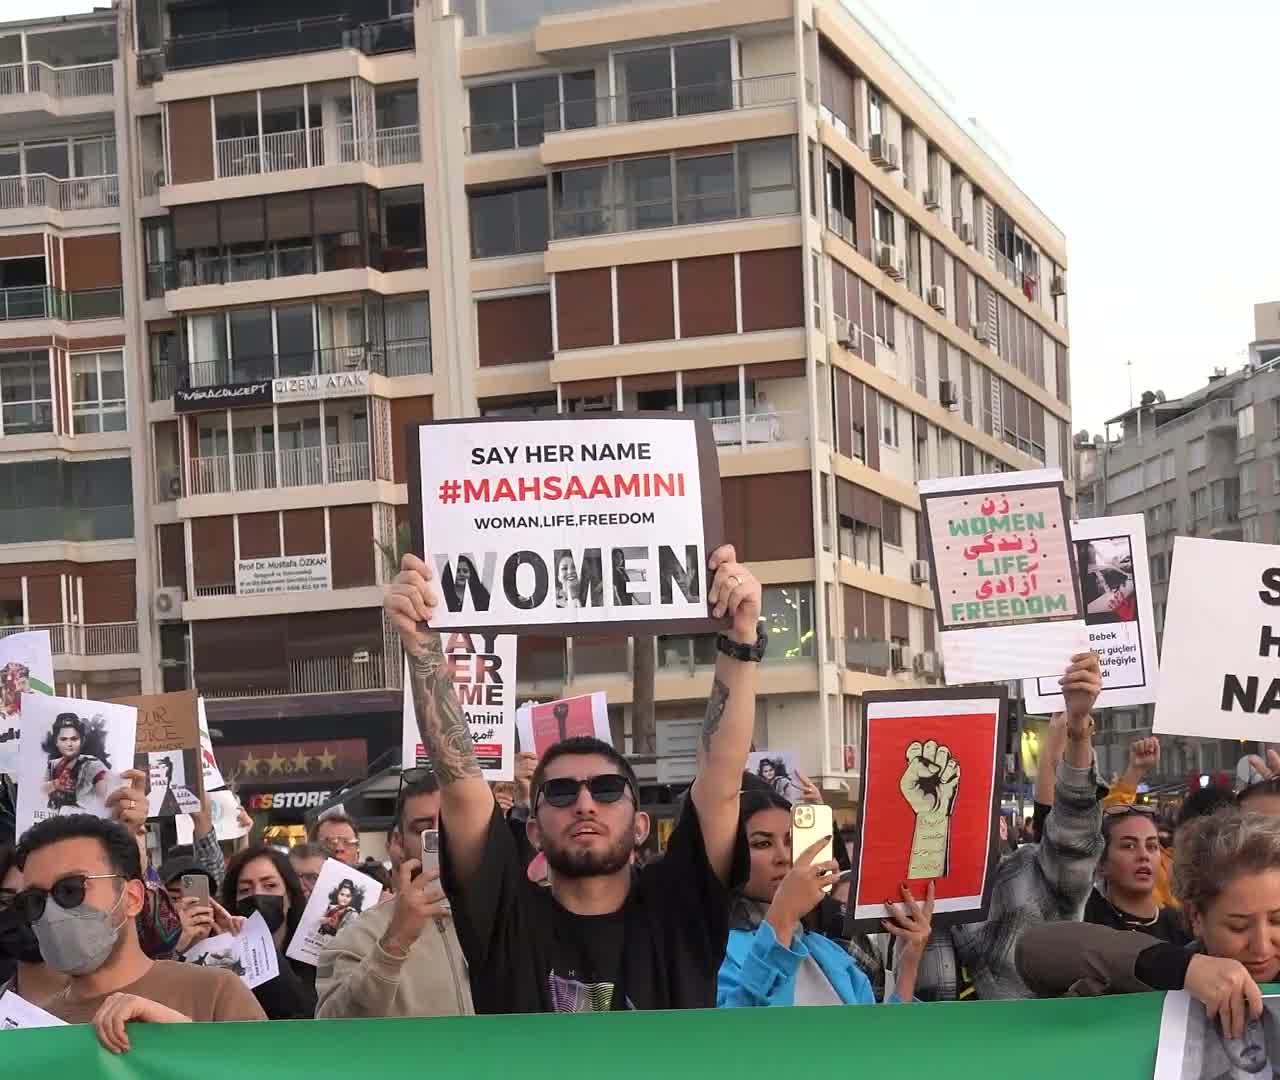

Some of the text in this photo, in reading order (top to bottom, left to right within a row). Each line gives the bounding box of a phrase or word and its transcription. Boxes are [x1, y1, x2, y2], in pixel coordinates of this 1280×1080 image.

[471, 442, 652, 465] SAY HER NAME
[438, 473, 686, 504] #MAHSAAMINI
[981, 494, 1010, 516] زن
[949, 512, 1046, 537] WOMEN
[976, 555, 1031, 577] LIFE
[434, 545, 701, 612] WOMEN
[951, 594, 1069, 621] FREEDOM
[445, 633, 500, 654] AY
[1089, 631, 1117, 642] Bebek
[1100, 655, 1137, 667] tüfeğiyle
[1107, 644, 1137, 656] güçleri
[447, 654, 504, 684] ER
